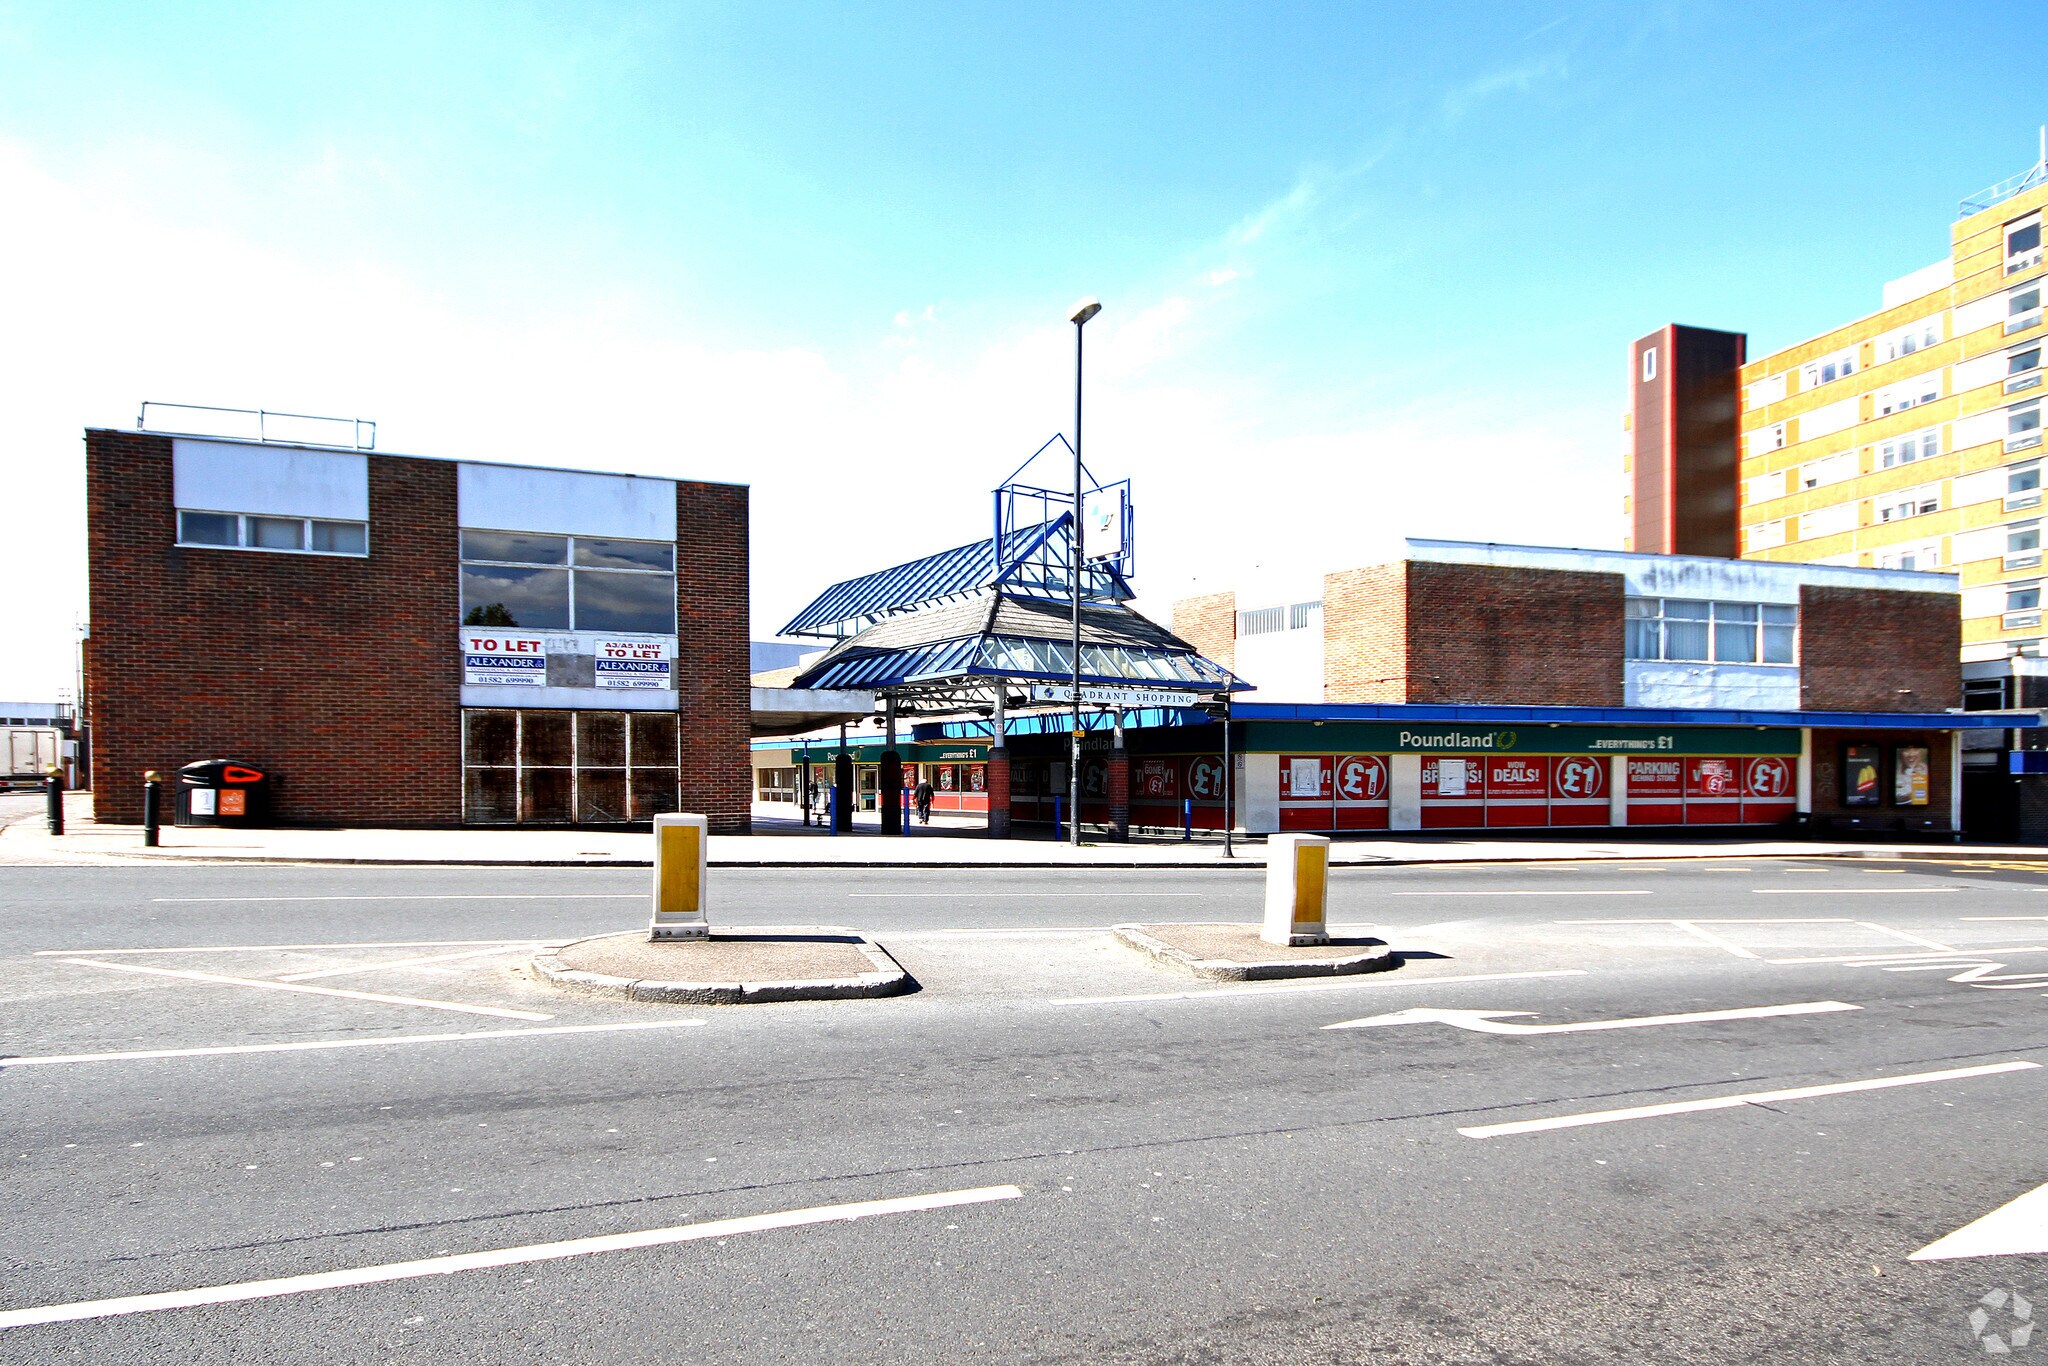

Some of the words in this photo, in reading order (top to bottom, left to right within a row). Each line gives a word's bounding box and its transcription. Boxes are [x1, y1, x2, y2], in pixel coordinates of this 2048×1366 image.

[470, 639, 498, 651] TO
[505, 640, 541, 652] LET
[605, 649, 627, 657] TO
[633, 650, 661, 658] LET
[468, 657, 534, 668] ALEXANDER
[599, 662, 660, 672] ALEXANDER
[1063, 689, 1128, 701] QADRANT
[1136, 693, 1192, 703] SHOPPING
[1400, 731, 1493, 748] Poundland
[1657, 736, 1673, 749] £1
[969, 749, 976, 758] £1
[1628, 762, 1680, 774] PARKING
[1087, 765, 1108, 794] £1
[1194, 763, 1222, 796] £1
[1343, 762, 1379, 795] £1
[1493, 768, 1540, 782] DEALS!
[1563, 763, 1595, 793] £1
[1631, 774, 1655, 782] BEHIND
[1657, 774, 1677, 782] STORE
[1754, 764, 1783, 793] £1
